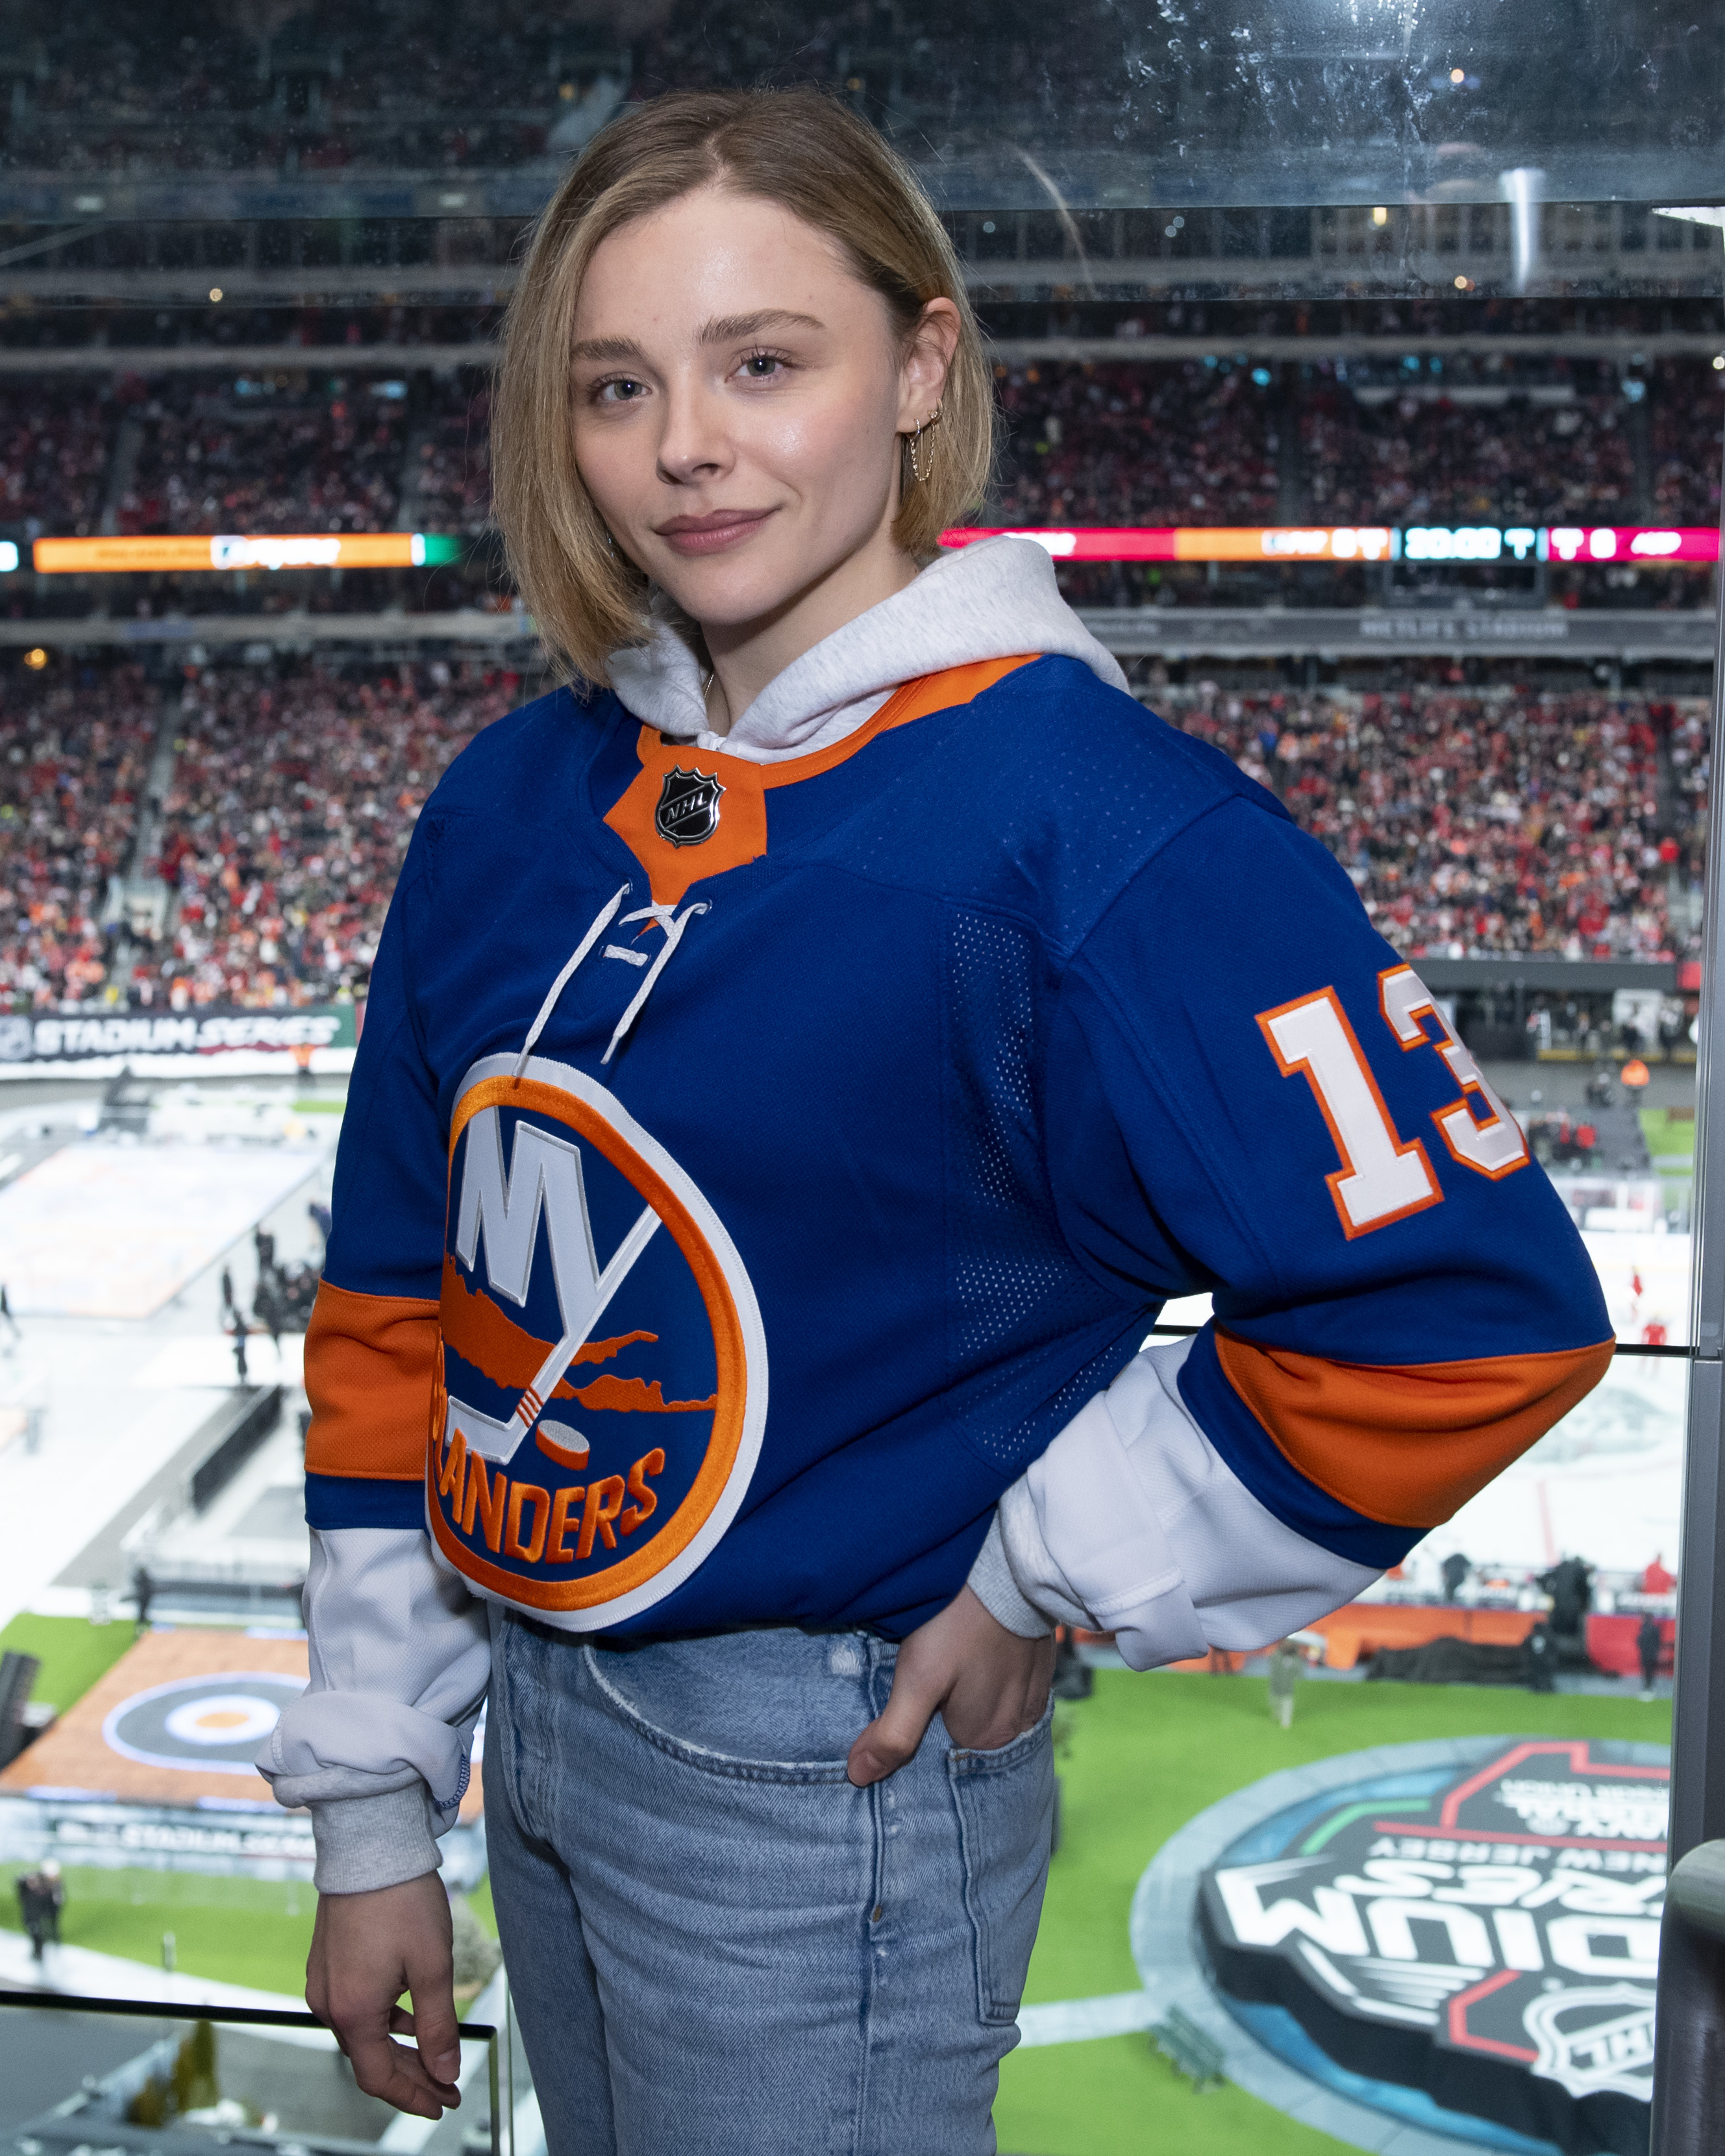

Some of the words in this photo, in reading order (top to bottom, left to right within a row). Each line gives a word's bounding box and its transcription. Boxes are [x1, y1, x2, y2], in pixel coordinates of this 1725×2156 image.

[665, 791, 708, 824] NHL
[34, 1018, 196, 1056] STADIUM
[198, 1016, 341, 1047] SERIES
[1254, 963, 1531, 1242] 13
[434, 1389, 665, 1565] ANDERS
[1369, 1837, 1552, 1867] JERSEY
[1556, 1848, 1667, 1874] NEW
[1332, 1858, 1667, 1916] RIES
[1215, 1865, 1663, 1980] DIUM
[1572, 2023, 1655, 2066] HL
